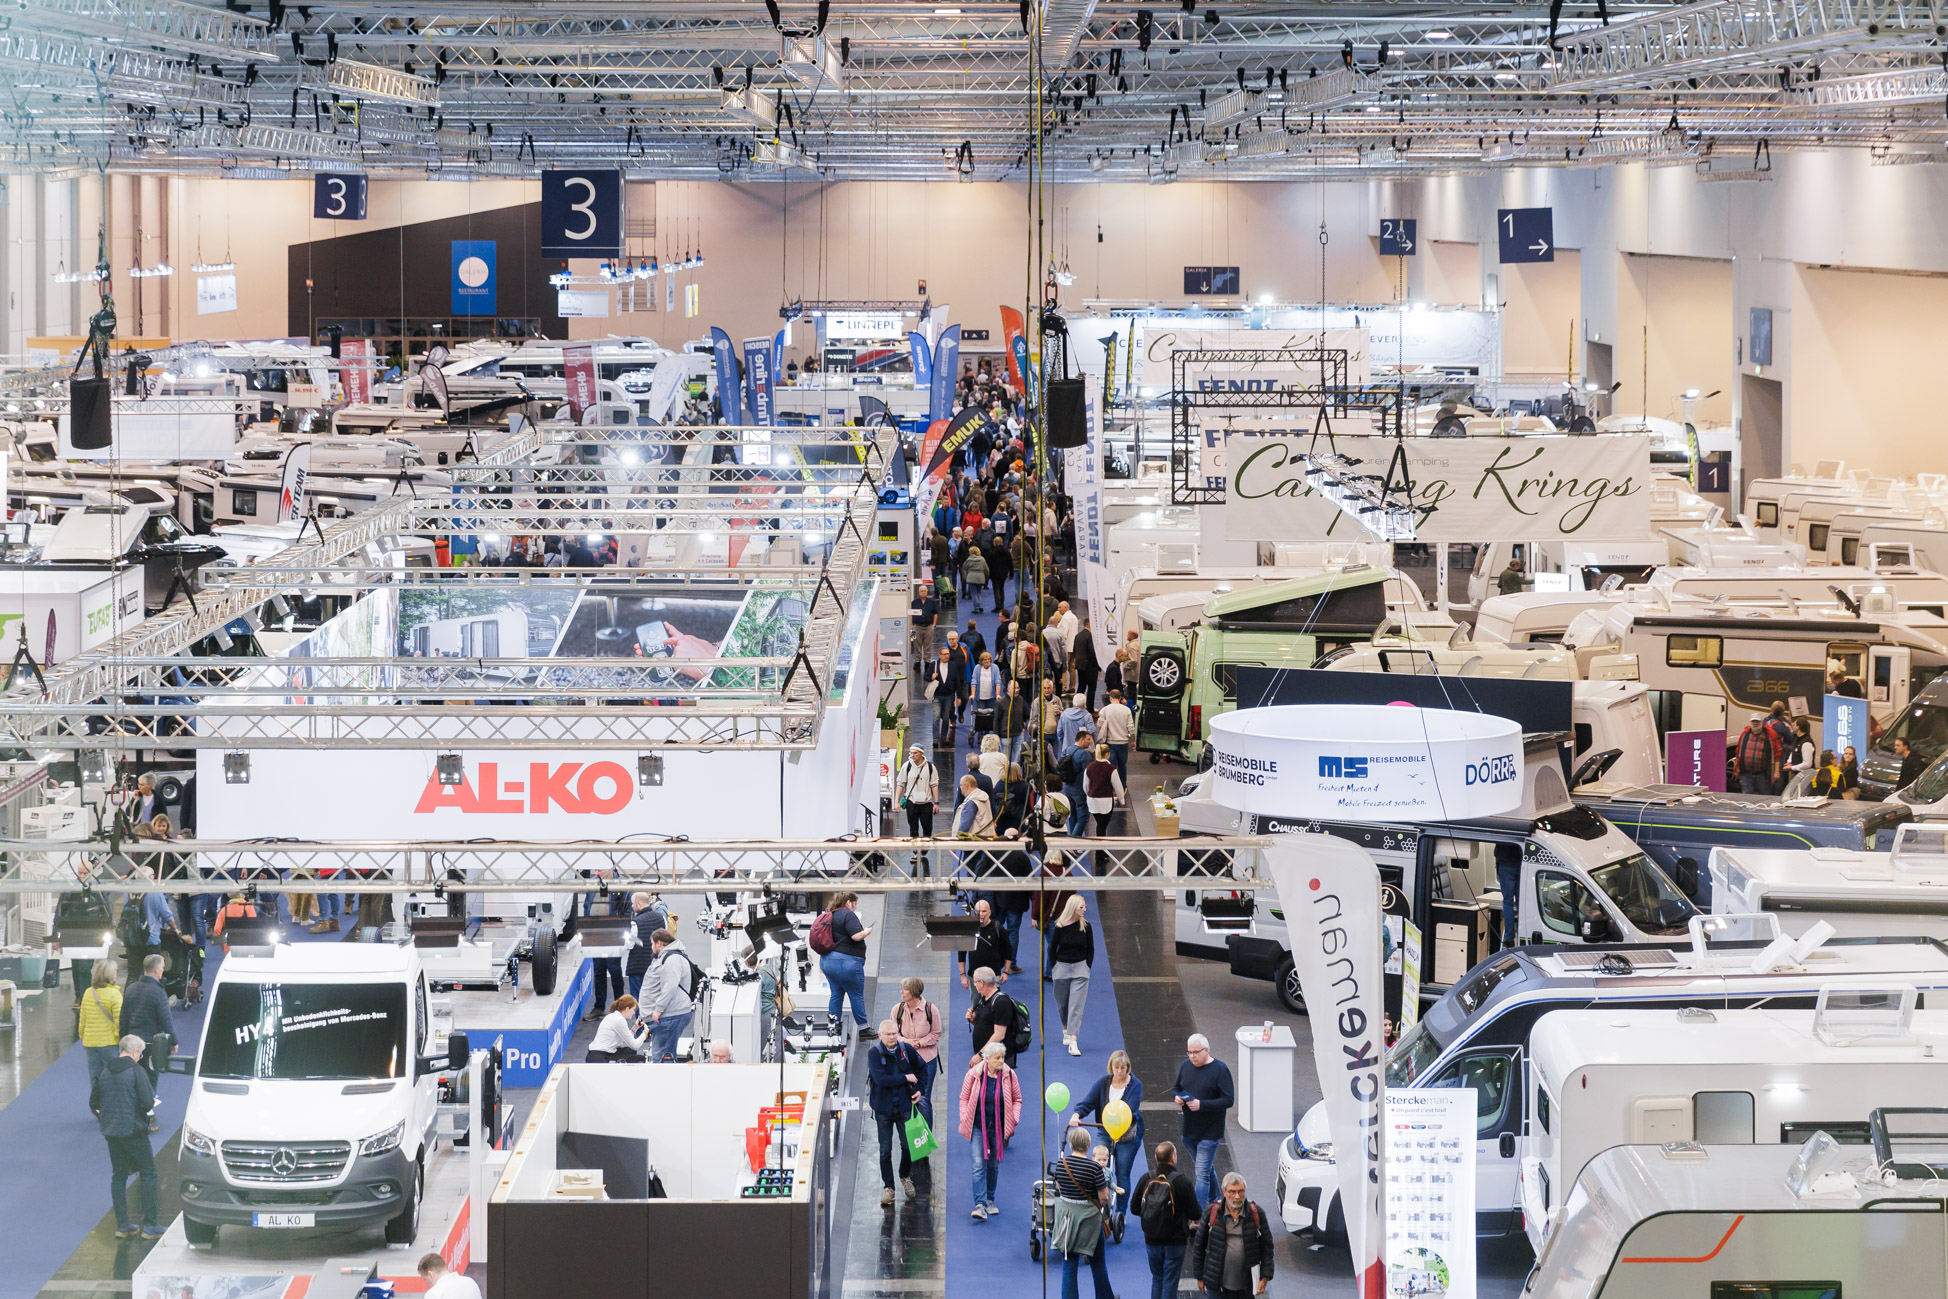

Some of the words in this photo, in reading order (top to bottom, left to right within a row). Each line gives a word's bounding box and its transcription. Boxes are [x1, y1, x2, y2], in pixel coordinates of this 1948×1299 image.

[326, 177, 348, 216] 3
[563, 176, 598, 241] 3
[1382, 220, 1395, 239] 2
[1502, 212, 1515, 239] 1
[458, 287, 490, 295] RESTAURANT
[941, 413, 985, 454] EMUK
[1708, 466, 1718, 489] 1
[1473, 446, 1642, 534] Krings
[1218, 750, 1278, 773] REISEMOBILE
[1369, 755, 1427, 764] REISEMOBILE
[413, 760, 634, 816] AL-KO
[1218, 766, 1265, 787] BRUMBERG
[1337, 797, 1361, 807] Mobile
[282, 1018, 327, 1033] bescheinigung
[327, 1017, 339, 1026] von
[340, 1011, 388, 1025] Mercedes-Benz
[506, 1047, 542, 1070] Pro
[268, 1215, 282, 1226] AL
[287, 1215, 301, 1226] KO
